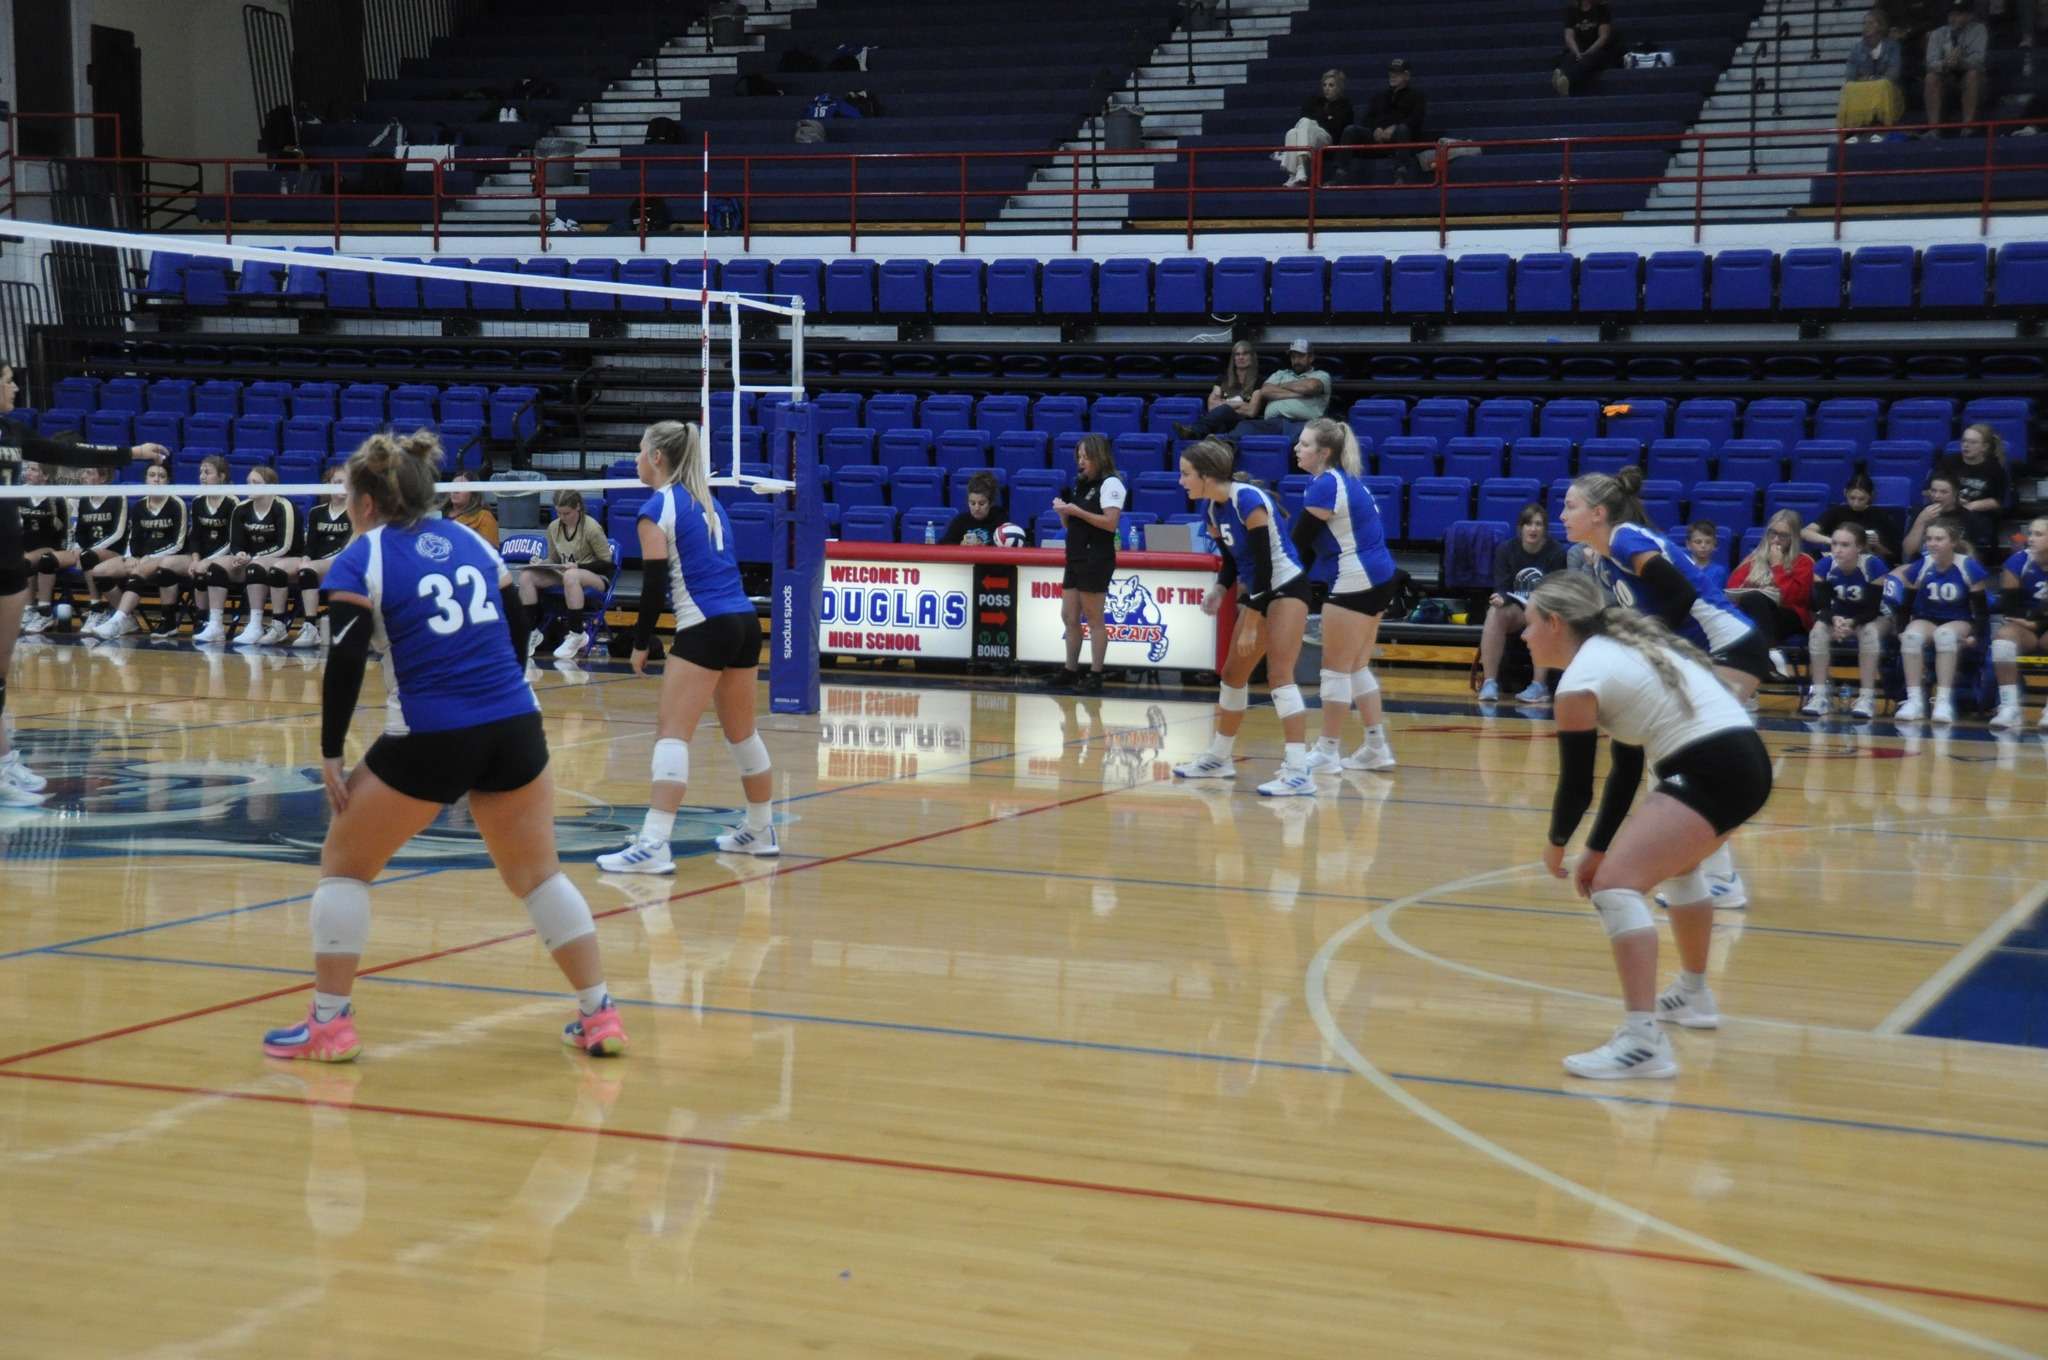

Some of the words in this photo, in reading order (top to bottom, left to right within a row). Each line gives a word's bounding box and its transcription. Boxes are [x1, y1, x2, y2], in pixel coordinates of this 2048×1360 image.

[502, 538, 543, 558] DOUGLAS
[830, 565, 899, 585] WELCOME
[902, 568, 921, 586] TO
[418, 564, 500, 635] 32
[979, 593, 1011, 607] POSS
[1031, 582, 1063, 600] HOM
[1156, 586, 1175, 605] OF
[1177, 587, 1205, 606] THE
[1833, 585, 1862, 601] 13
[1926, 582, 1959, 601] 10
[782, 584, 793, 619] sports
[820, 587, 968, 630] OUGLAS
[782, 618, 793, 660] imports
[828, 631, 863, 649] HIGH
[866, 632, 922, 652] SCHOOL
[977, 645, 1011, 658] BONUS
